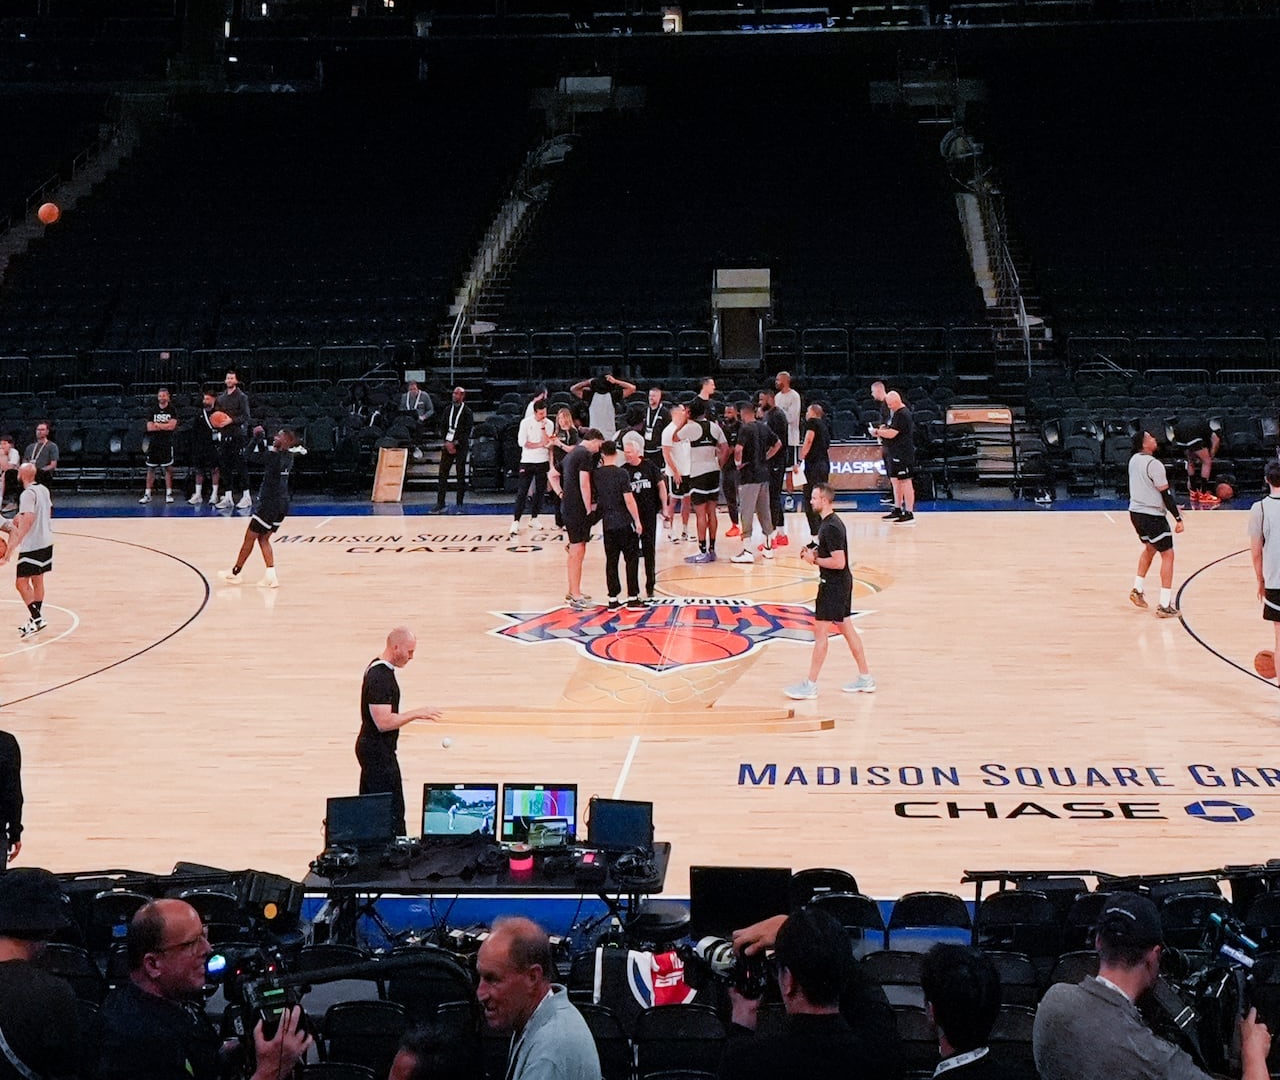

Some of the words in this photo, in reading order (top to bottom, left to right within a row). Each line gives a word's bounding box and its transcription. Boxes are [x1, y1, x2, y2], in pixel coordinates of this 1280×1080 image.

[830, 460, 873, 474] HASE
[274, 534, 406, 544] MADISON
[345, 546, 492, 554] CHASE
[683, 596, 751, 607] YORK
[737, 763, 960, 786] MADISON
[979, 763, 1175, 789] SQUARE
[894, 801, 1169, 819] CHASE
